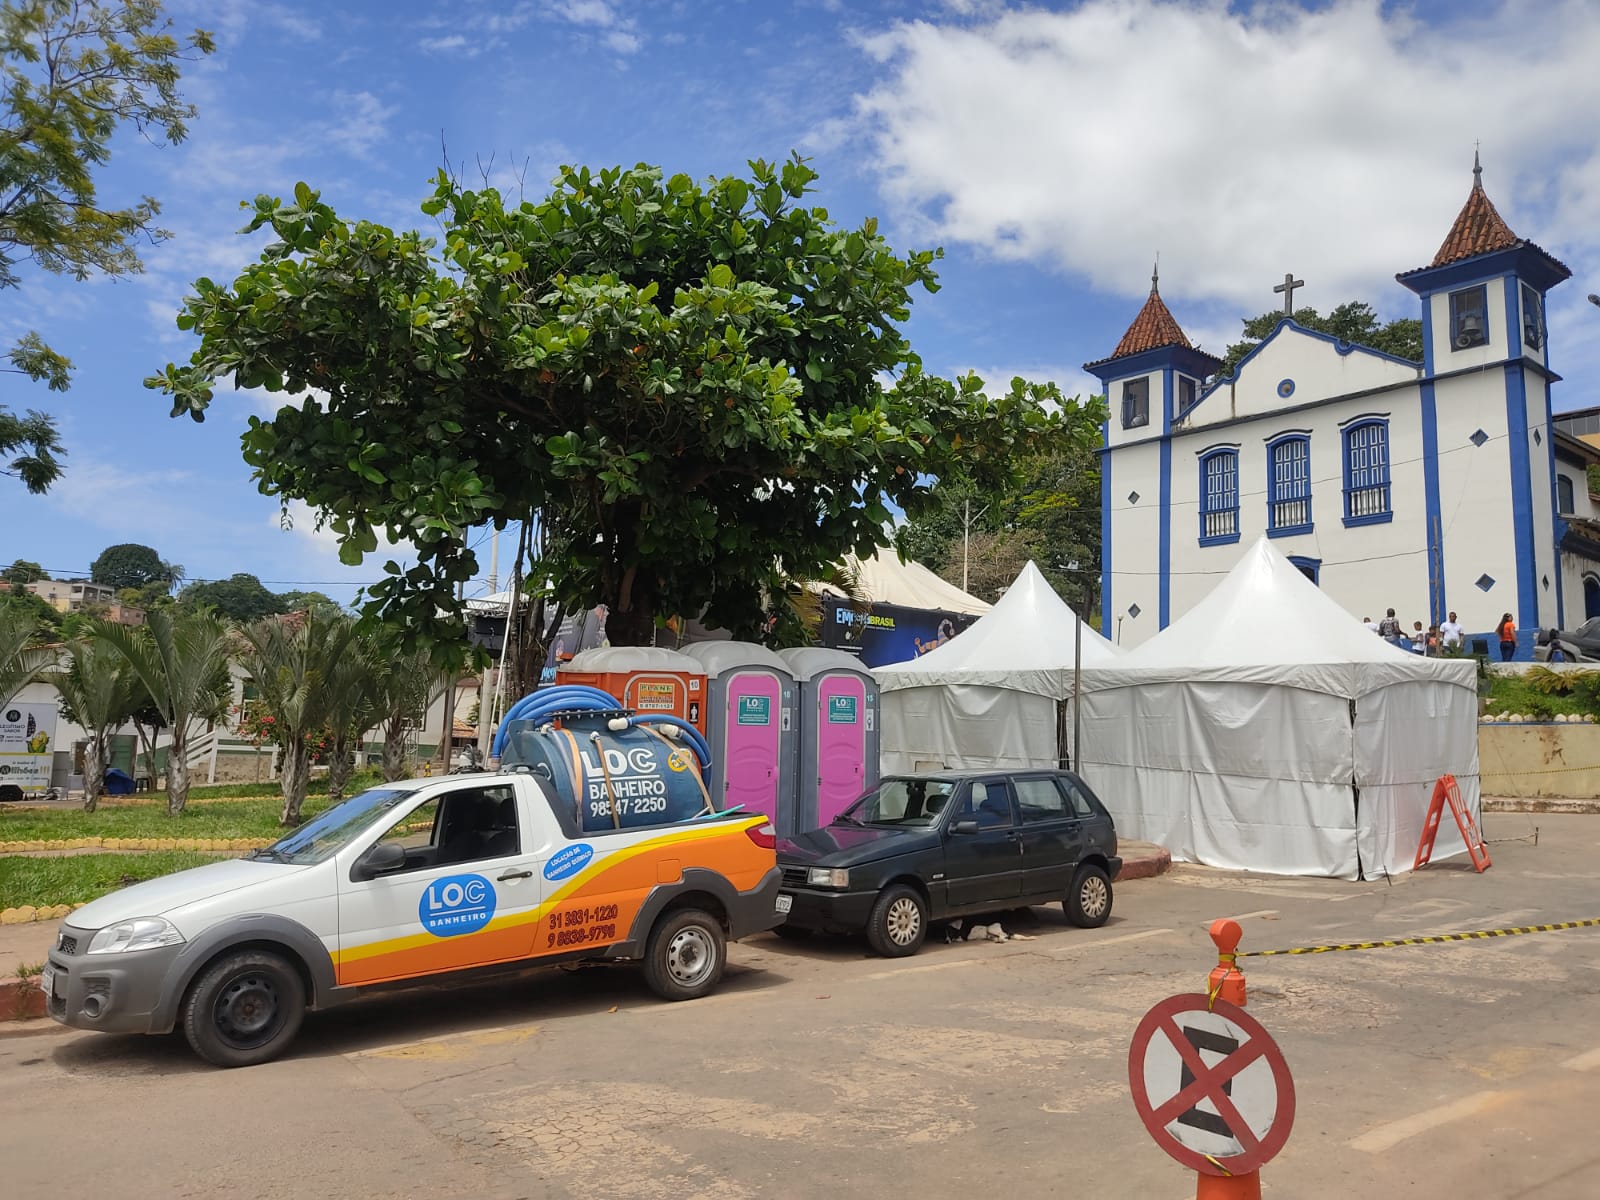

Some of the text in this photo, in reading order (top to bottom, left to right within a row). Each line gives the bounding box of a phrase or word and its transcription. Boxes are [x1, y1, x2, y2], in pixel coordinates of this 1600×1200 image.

[580, 748, 657, 778] LOC
[588, 780, 666, 800] BANHEIRO
[428, 879, 486, 910] LOC
[429, 912, 487, 927] BANHEIRO
[549, 912, 562, 930] 31
[547, 932, 556, 948] 9
